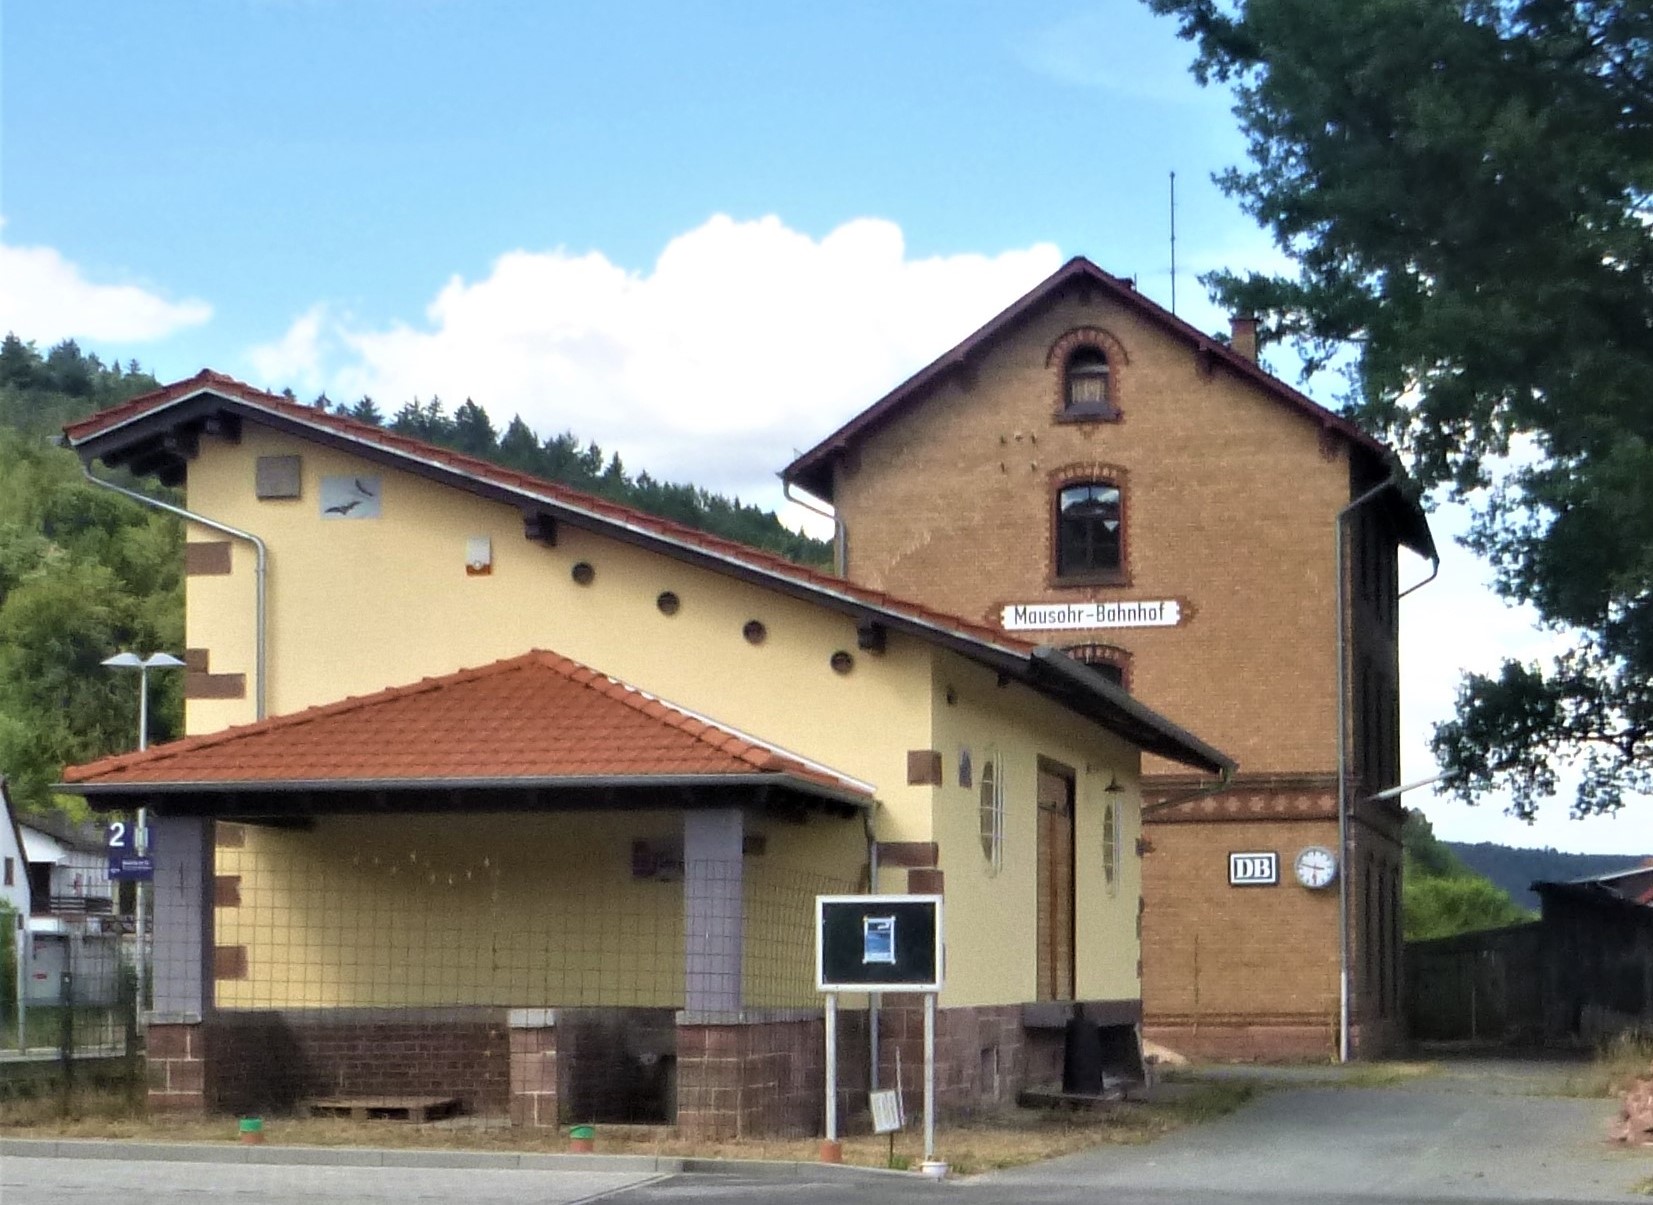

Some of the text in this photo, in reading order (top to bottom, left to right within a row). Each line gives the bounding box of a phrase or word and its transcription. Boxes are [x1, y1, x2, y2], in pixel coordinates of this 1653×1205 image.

[1014, 602, 1165, 625] Mausohr-Bahnhof
[109, 822, 125, 847] 2
[1235, 858, 1271, 878] DB
